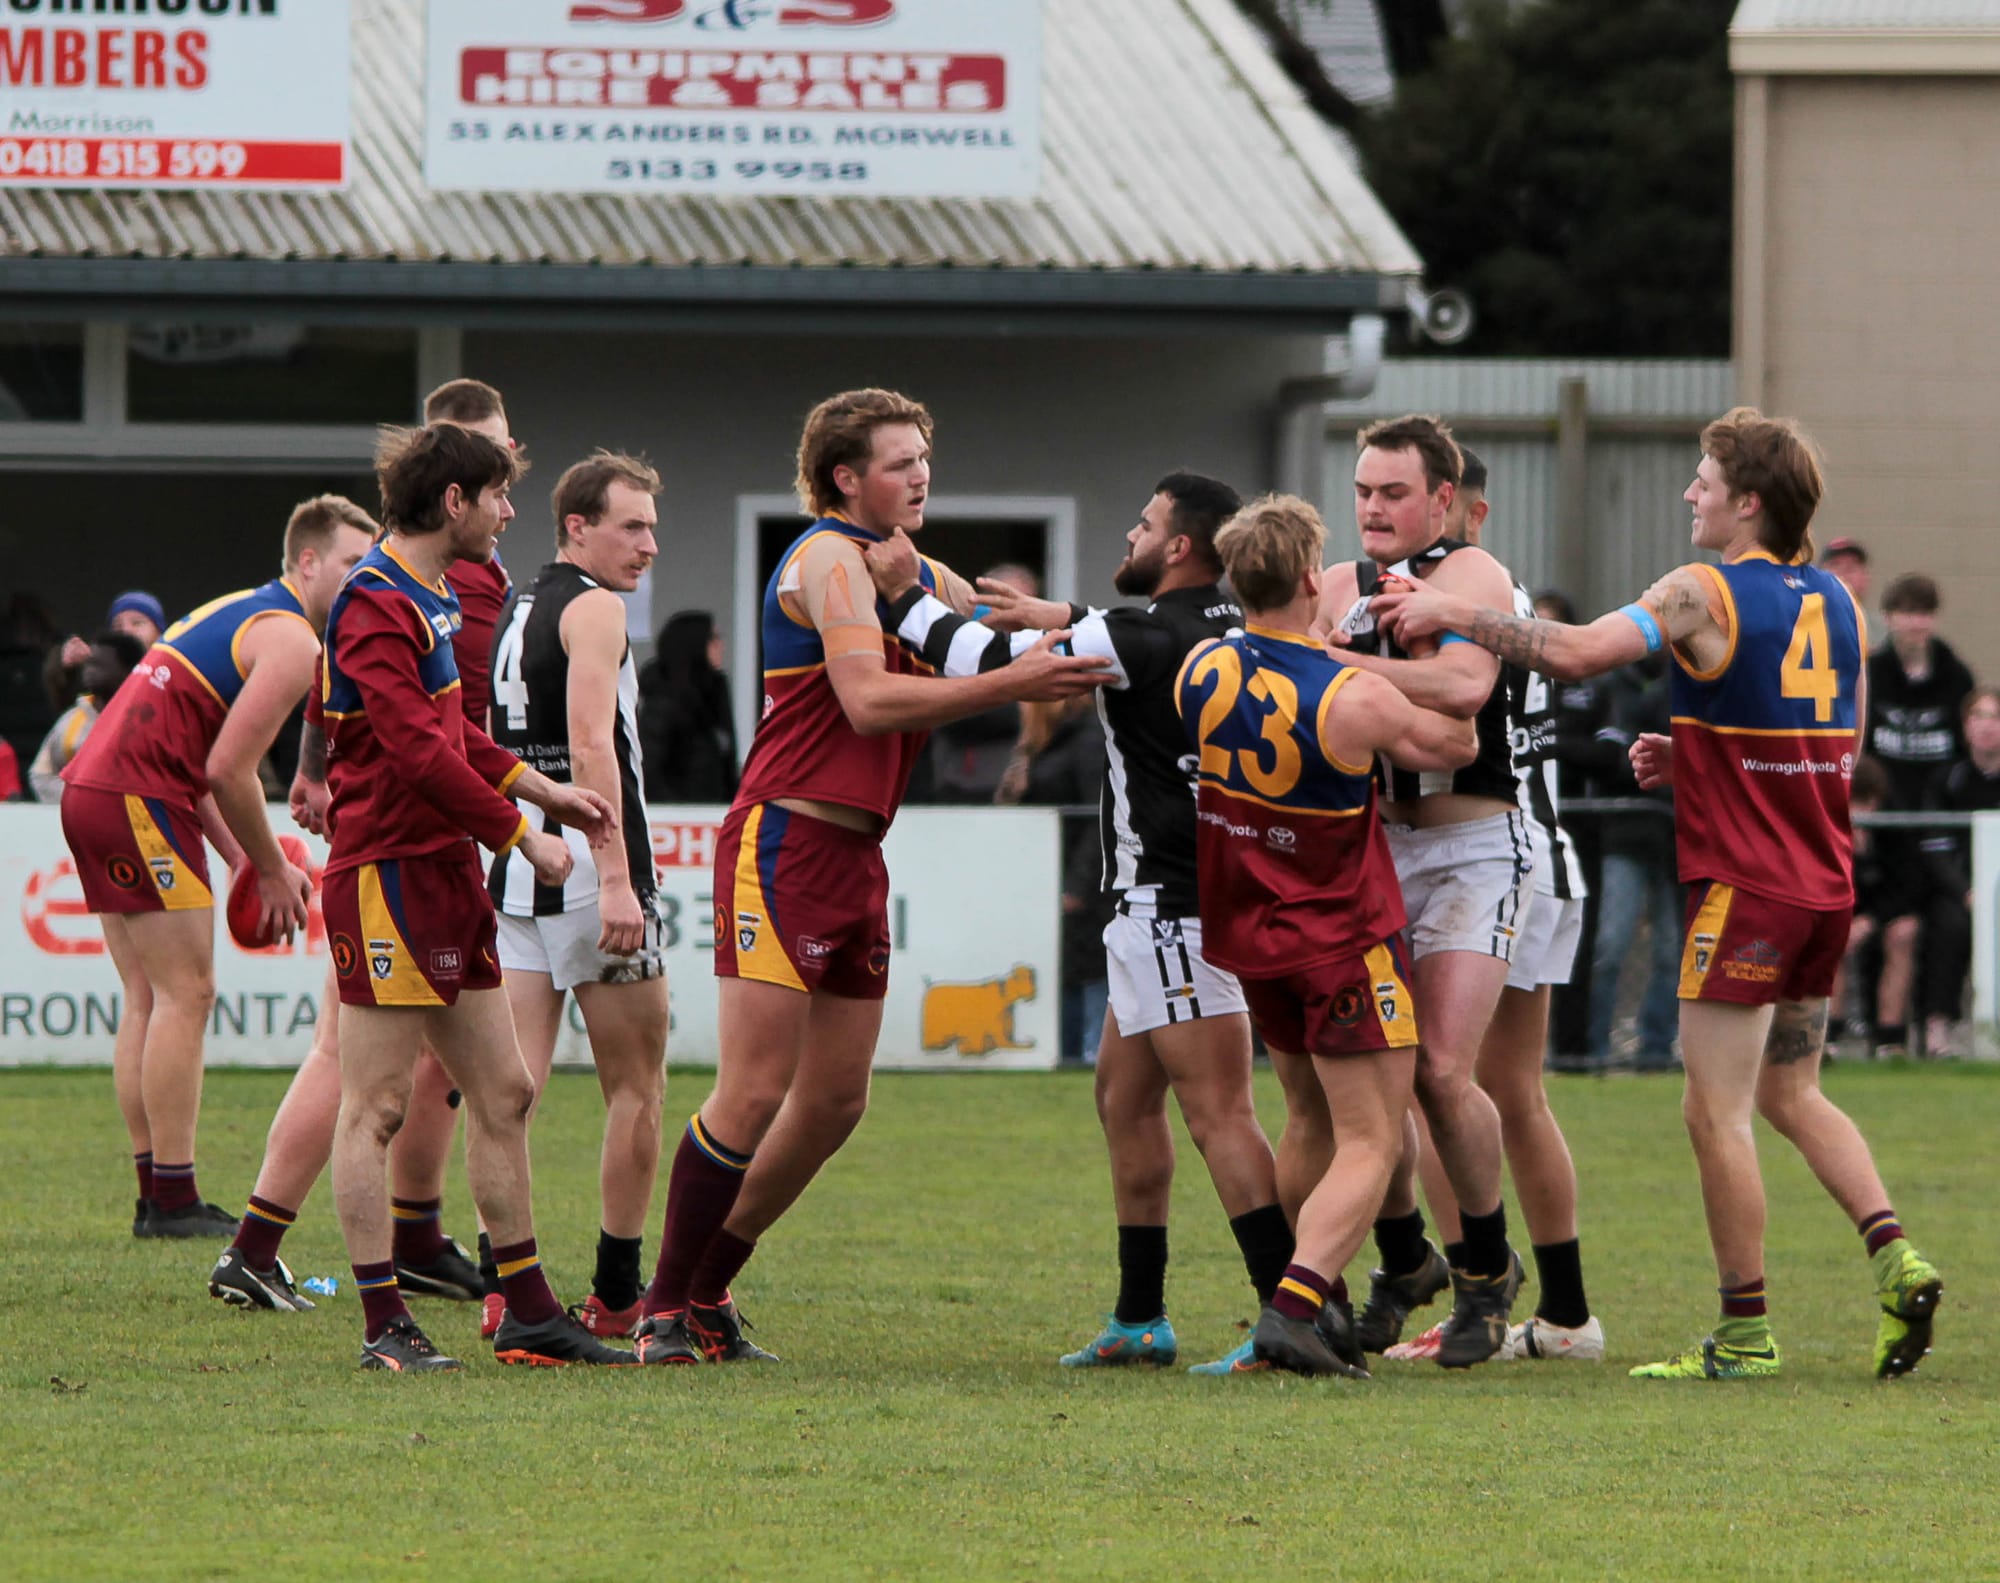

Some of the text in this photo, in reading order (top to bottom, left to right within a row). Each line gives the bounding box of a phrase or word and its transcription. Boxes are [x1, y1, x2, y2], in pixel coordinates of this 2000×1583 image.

[506, 51, 950, 81] EQUIPMENT
[475, 76, 989, 109] HIRE & SALES
[10, 109, 155, 132] Morrison
[835, 127, 1014, 147] MORWELL
[0, 141, 247, 176] 0418 515 599
[607, 159, 867, 181] 5133 9958
[493, 601, 533, 730] 4
[1781, 592, 1838, 722] 4
[1189, 645, 1302, 797] 23
[538, 759, 569, 771] Bank
[1742, 758, 1804, 776] Warragul
